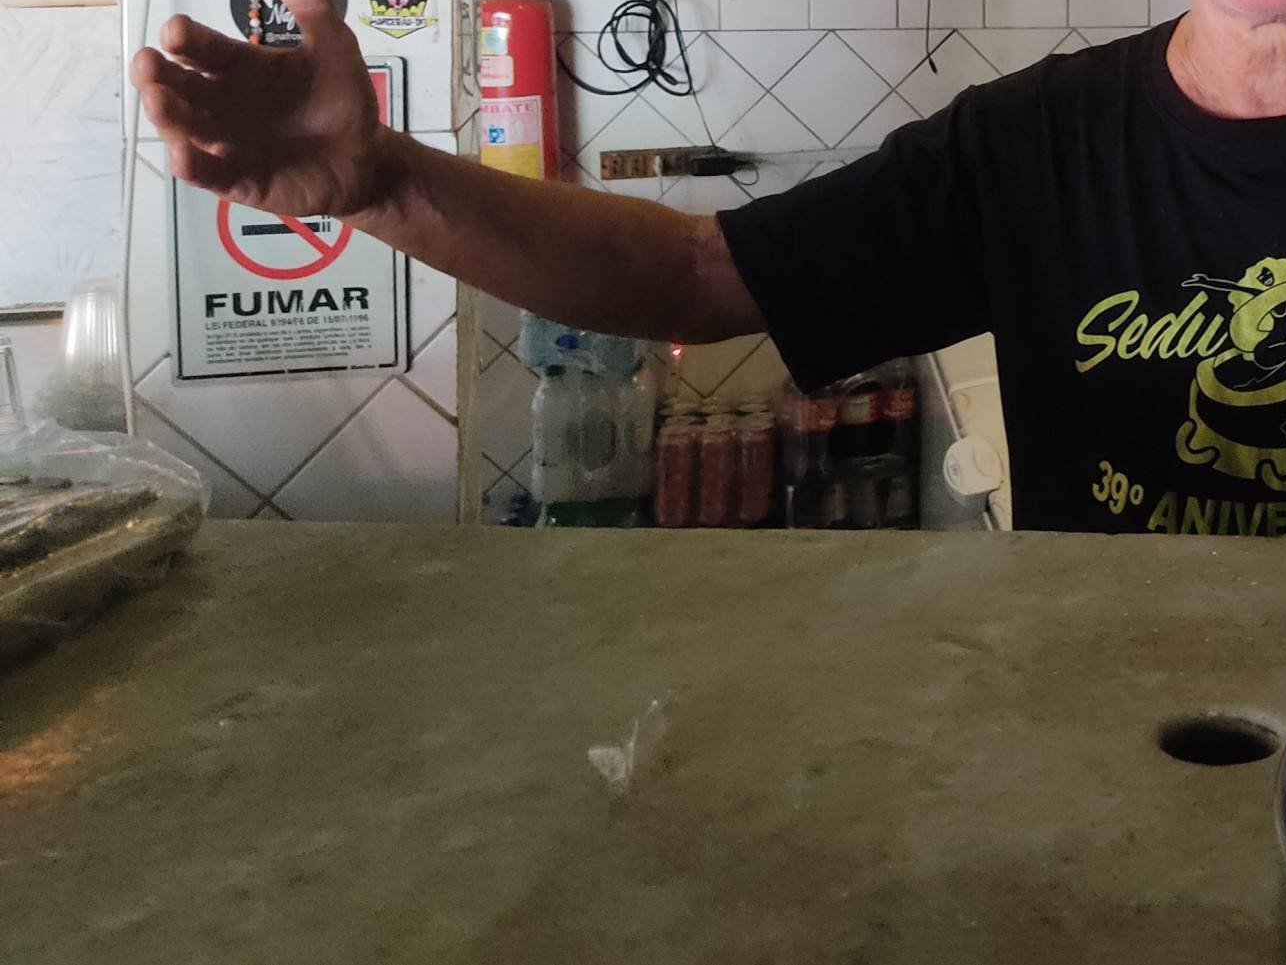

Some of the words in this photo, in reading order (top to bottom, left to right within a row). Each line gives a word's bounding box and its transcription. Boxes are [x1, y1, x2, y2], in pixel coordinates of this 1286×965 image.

[480, 103, 534, 114] MBATE
[205, 287, 369, 318] FUMAR
[205, 321, 221, 330] LEI
[223, 320, 267, 329] FEDERAL
[307, 316, 319, 325] DE
